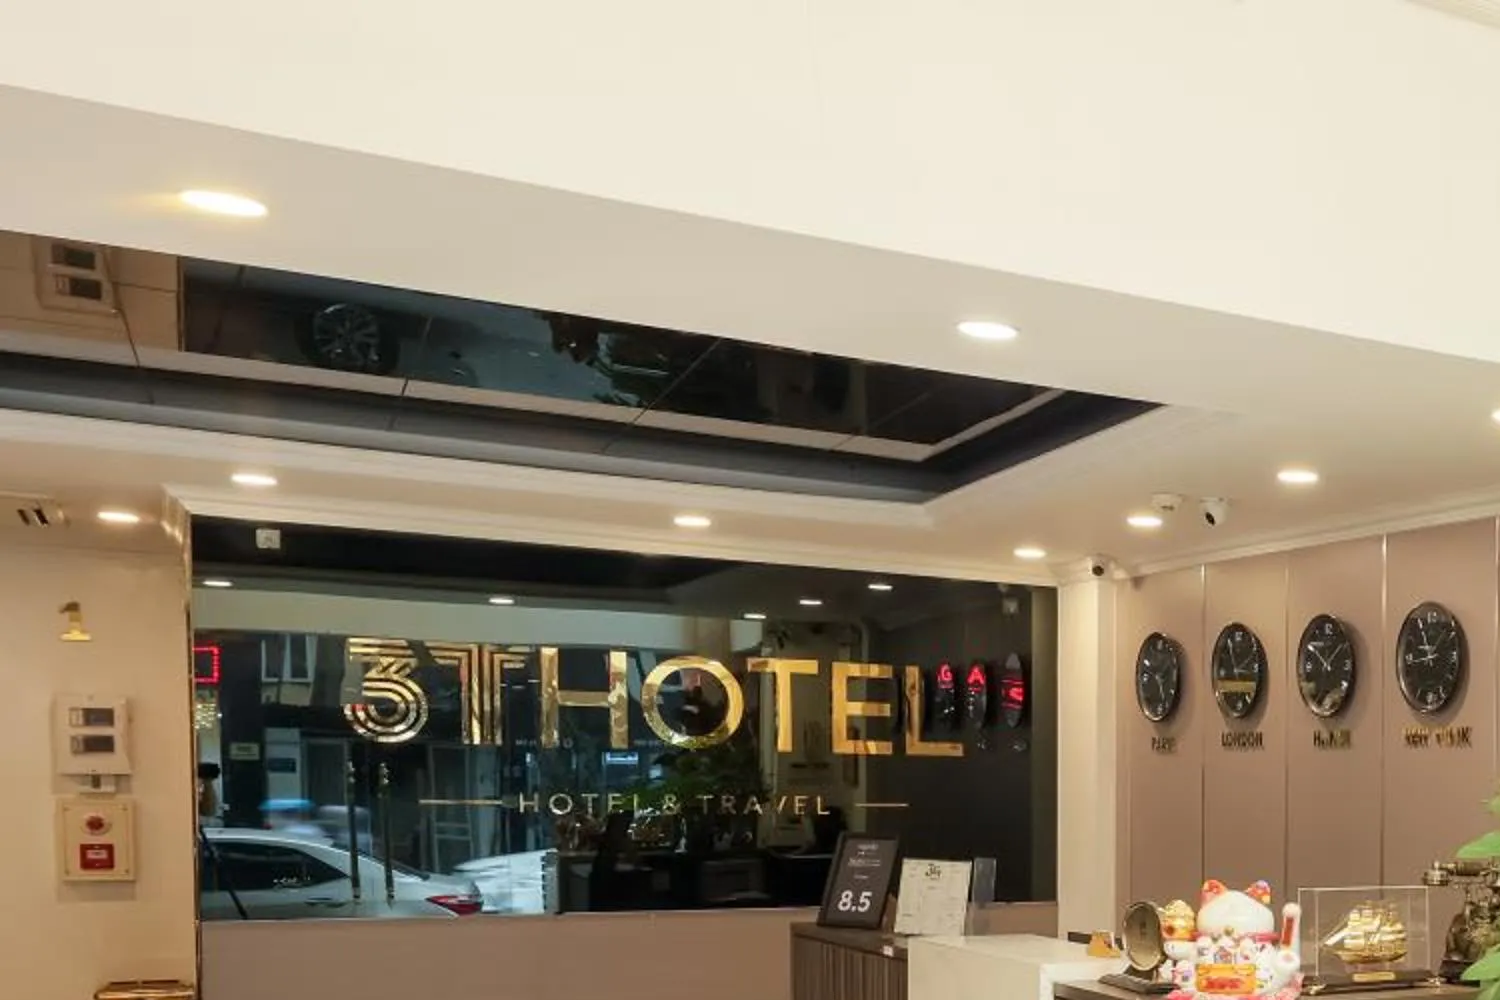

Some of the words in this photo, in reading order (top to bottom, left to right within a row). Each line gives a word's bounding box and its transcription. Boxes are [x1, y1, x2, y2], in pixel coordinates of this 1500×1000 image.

[1221, 732, 1263, 748] LONDON
[518, 793, 645, 815] HOTEL
[697, 794, 831, 815] TRAVEL
[837, 889, 873, 913] 8.5
